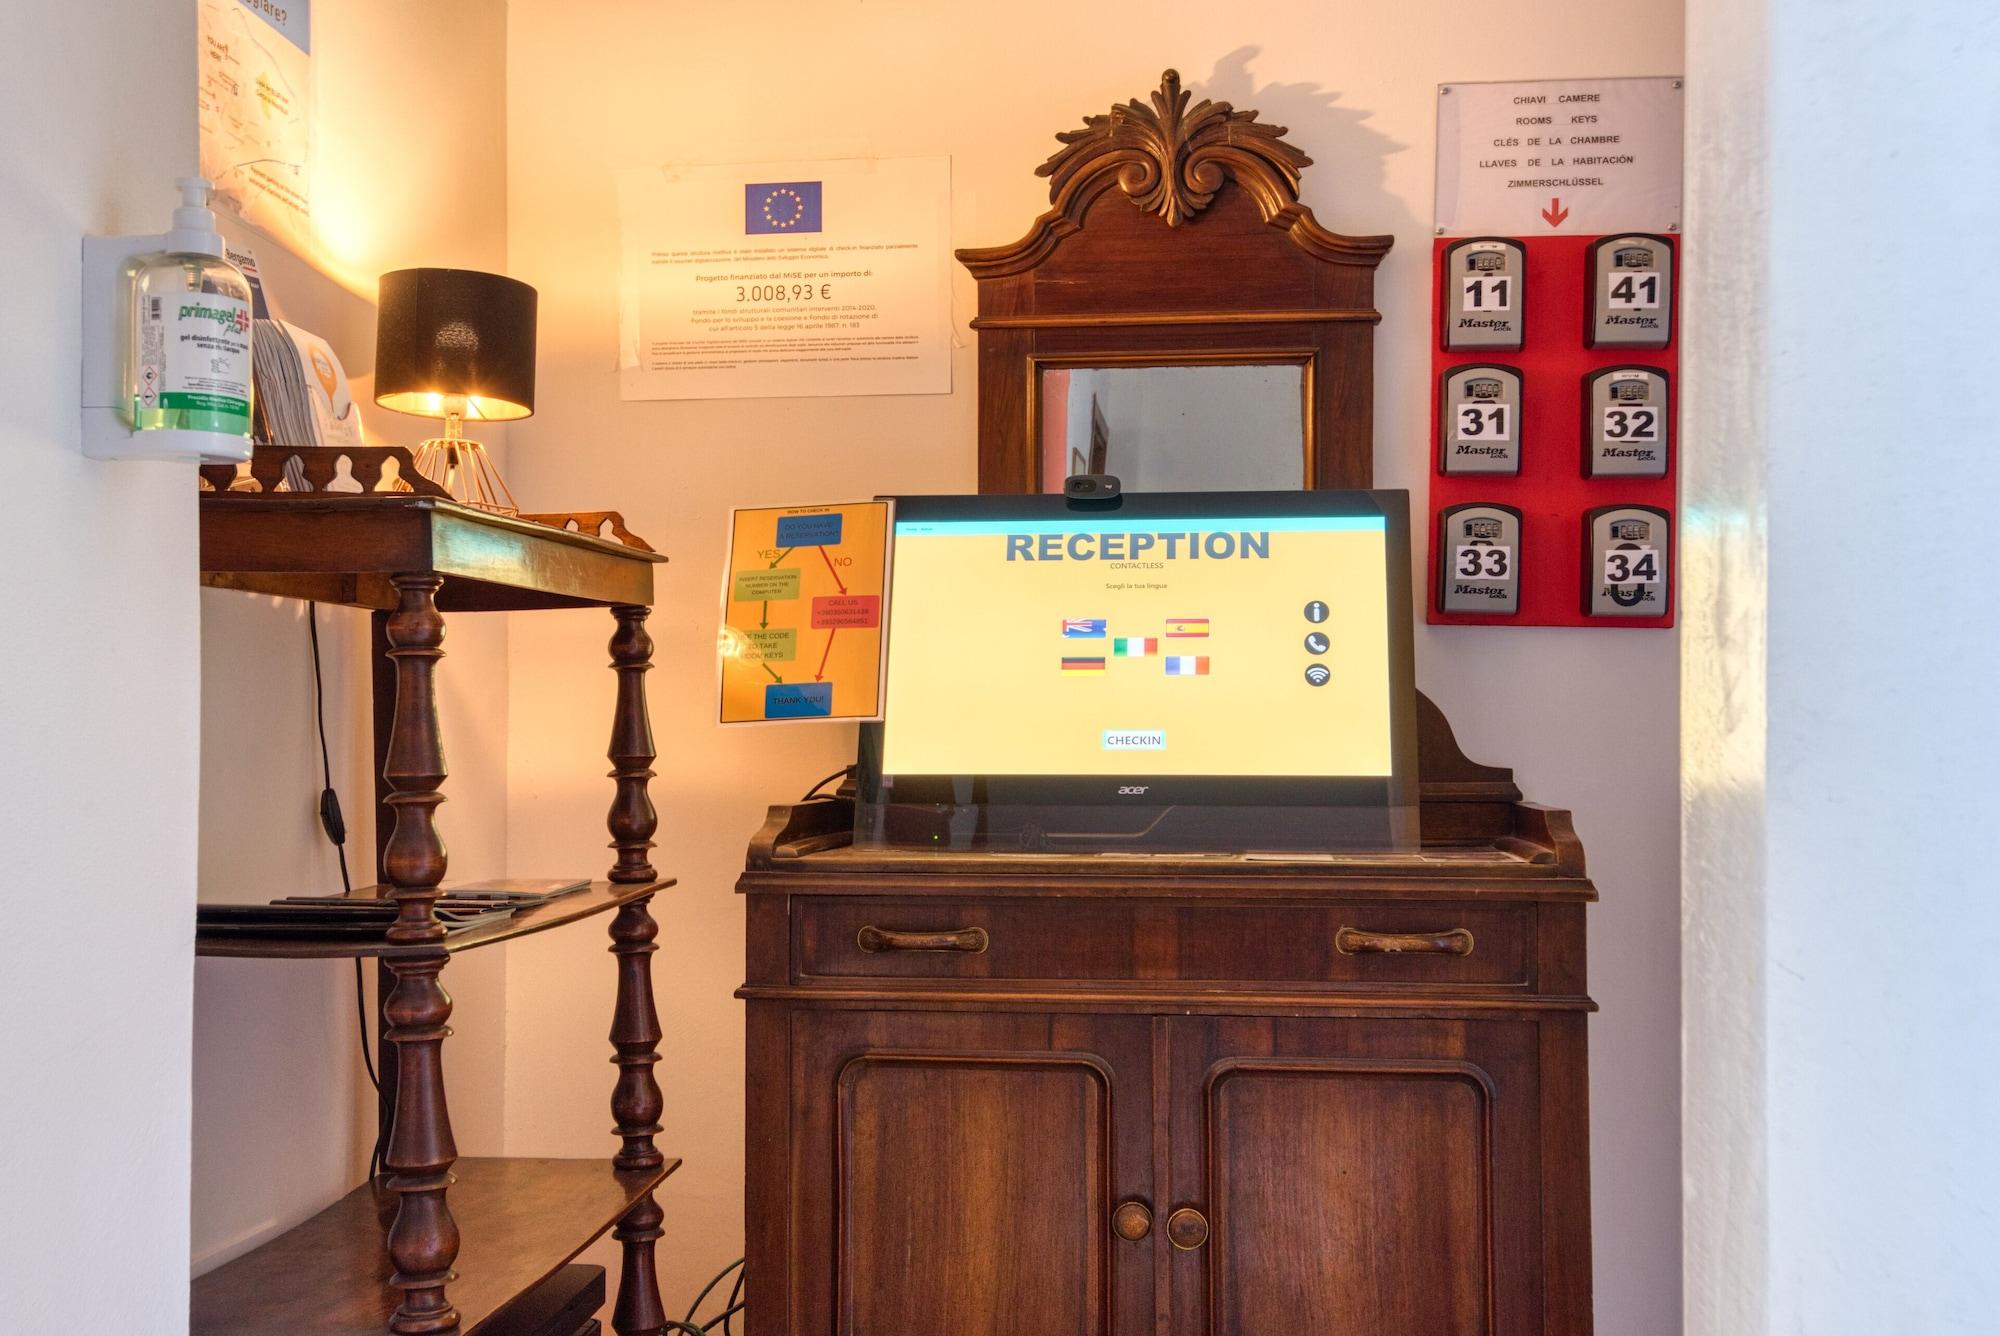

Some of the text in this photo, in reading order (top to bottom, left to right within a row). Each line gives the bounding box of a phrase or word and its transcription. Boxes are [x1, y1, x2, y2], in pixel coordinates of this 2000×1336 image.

[1513, 94, 1600, 104] CHIAVI CAMERE
[1516, 115, 1598, 125] ROOMS KEYS
[1493, 135, 1620, 147] CLÉS DE LA CHAMBRE
[1479, 155, 1634, 168] LLAVES DE LA HABITACIÓN
[1507, 177, 1604, 188] ZIMMERSCHLÜSSEL
[696, 274, 729, 283] Progetto
[730, 272, 768, 280] finanziato
[769, 271, 782, 279] dal
[804, 272, 818, 280] per
[831, 270, 862, 278] importo
[736, 283, 832, 302] 3.008,93 €
[1465, 276, 1657, 307] 11 41
[178, 302, 236, 325] primagel
[1458, 318, 1509, 328] Master
[1605, 315, 1657, 325] Master
[1461, 407, 1655, 438] 31 32
[1455, 445, 1506, 455] Master
[1601, 448, 1654, 458] Master
[1006, 532, 1270, 562] RECEPTION
[758, 550, 853, 567] YES NO
[1459, 549, 1657, 581] 33 34
[1454, 585, 1504, 595] Master
[764, 651, 784, 659] KEYS
[773, 695, 824, 705] THANK YOU!
[1107, 735, 1161, 745] CHECKIN
[1118, 786, 1149, 795] acer
